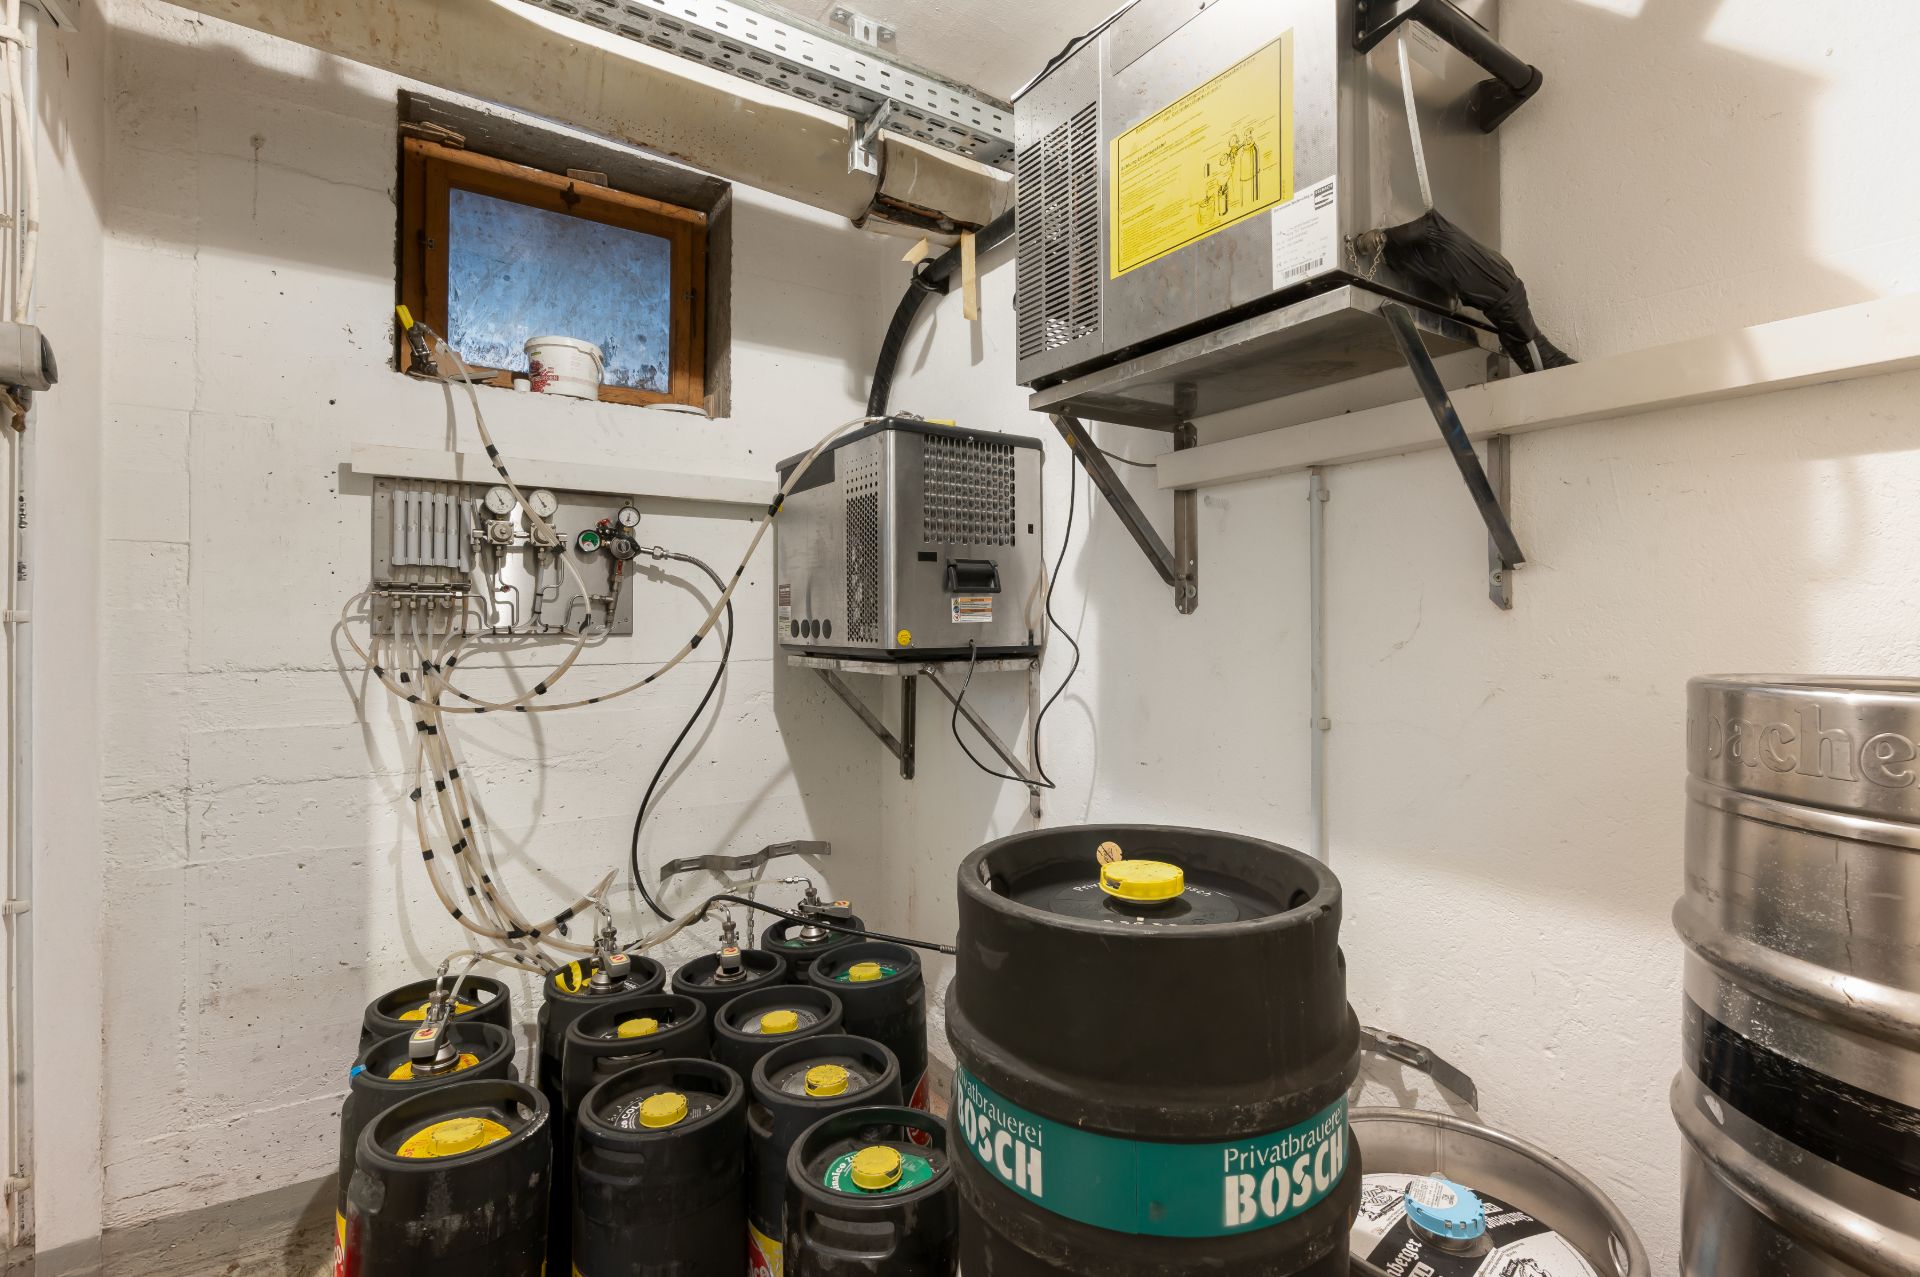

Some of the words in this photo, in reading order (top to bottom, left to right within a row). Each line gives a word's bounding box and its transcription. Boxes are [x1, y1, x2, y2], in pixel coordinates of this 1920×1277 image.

[957, 1078, 1043, 1198] BOSCH
[1224, 1103, 1343, 1173] Privatbrauerei
[831, 1162, 847, 1192] inalco
[1224, 1124, 1343, 1227] BOSCH
[1386, 1238, 1423, 1277] nberger
